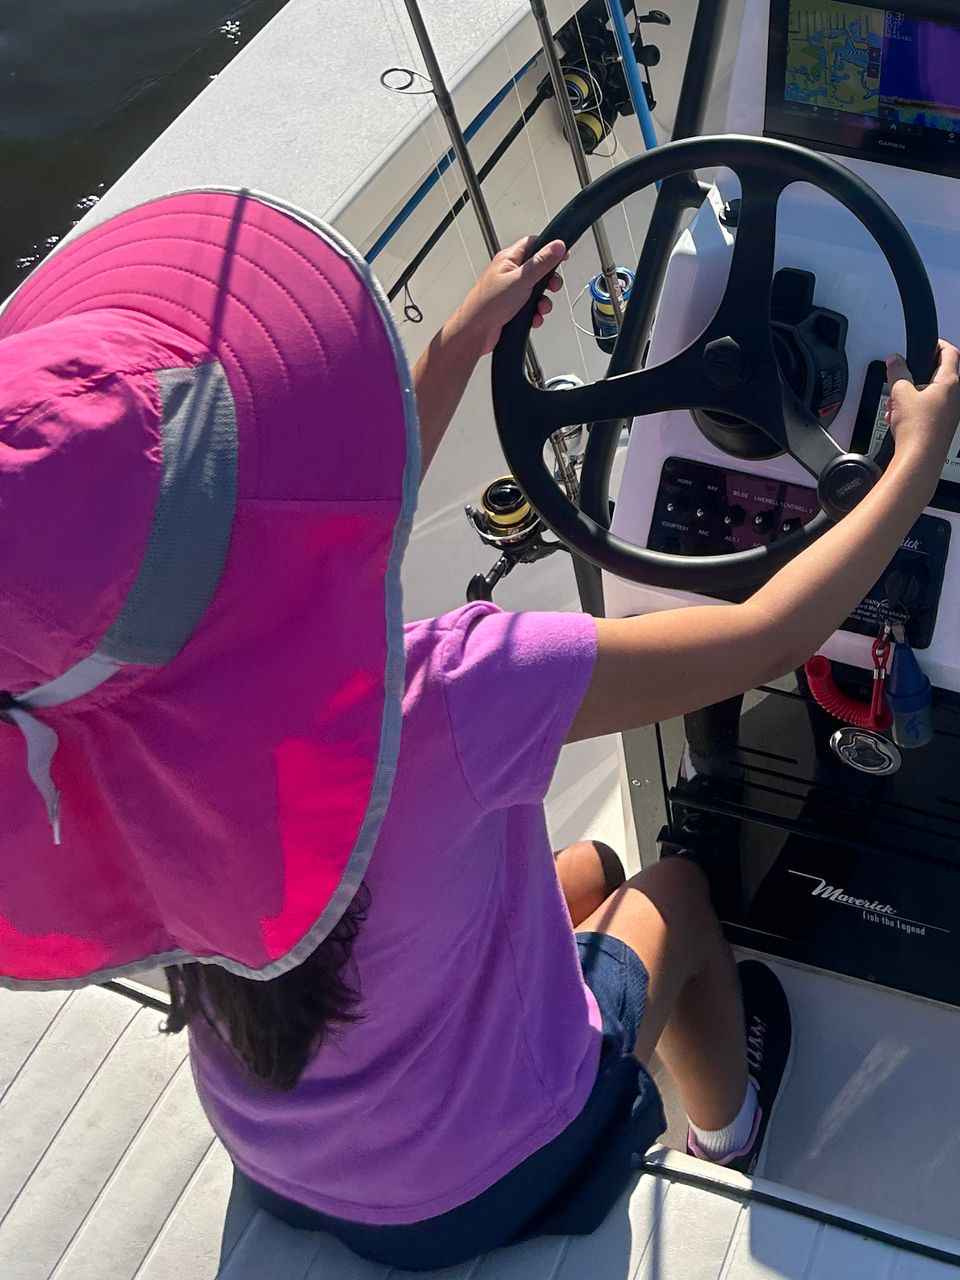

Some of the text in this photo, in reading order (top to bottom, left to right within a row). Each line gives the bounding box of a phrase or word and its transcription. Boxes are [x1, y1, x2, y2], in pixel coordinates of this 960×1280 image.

[878, 139, 906, 150] GARMIN
[733, 490, 749, 498] BILGE
[754, 495, 779, 506] LIVEWELL
[783, 502, 808, 513] LIVEWELL
[661, 520, 689, 531] COURTESY
[811, 879, 897, 914] Maverick
[882, 917, 895, 927] the
[897, 920, 926, 936] Legend
